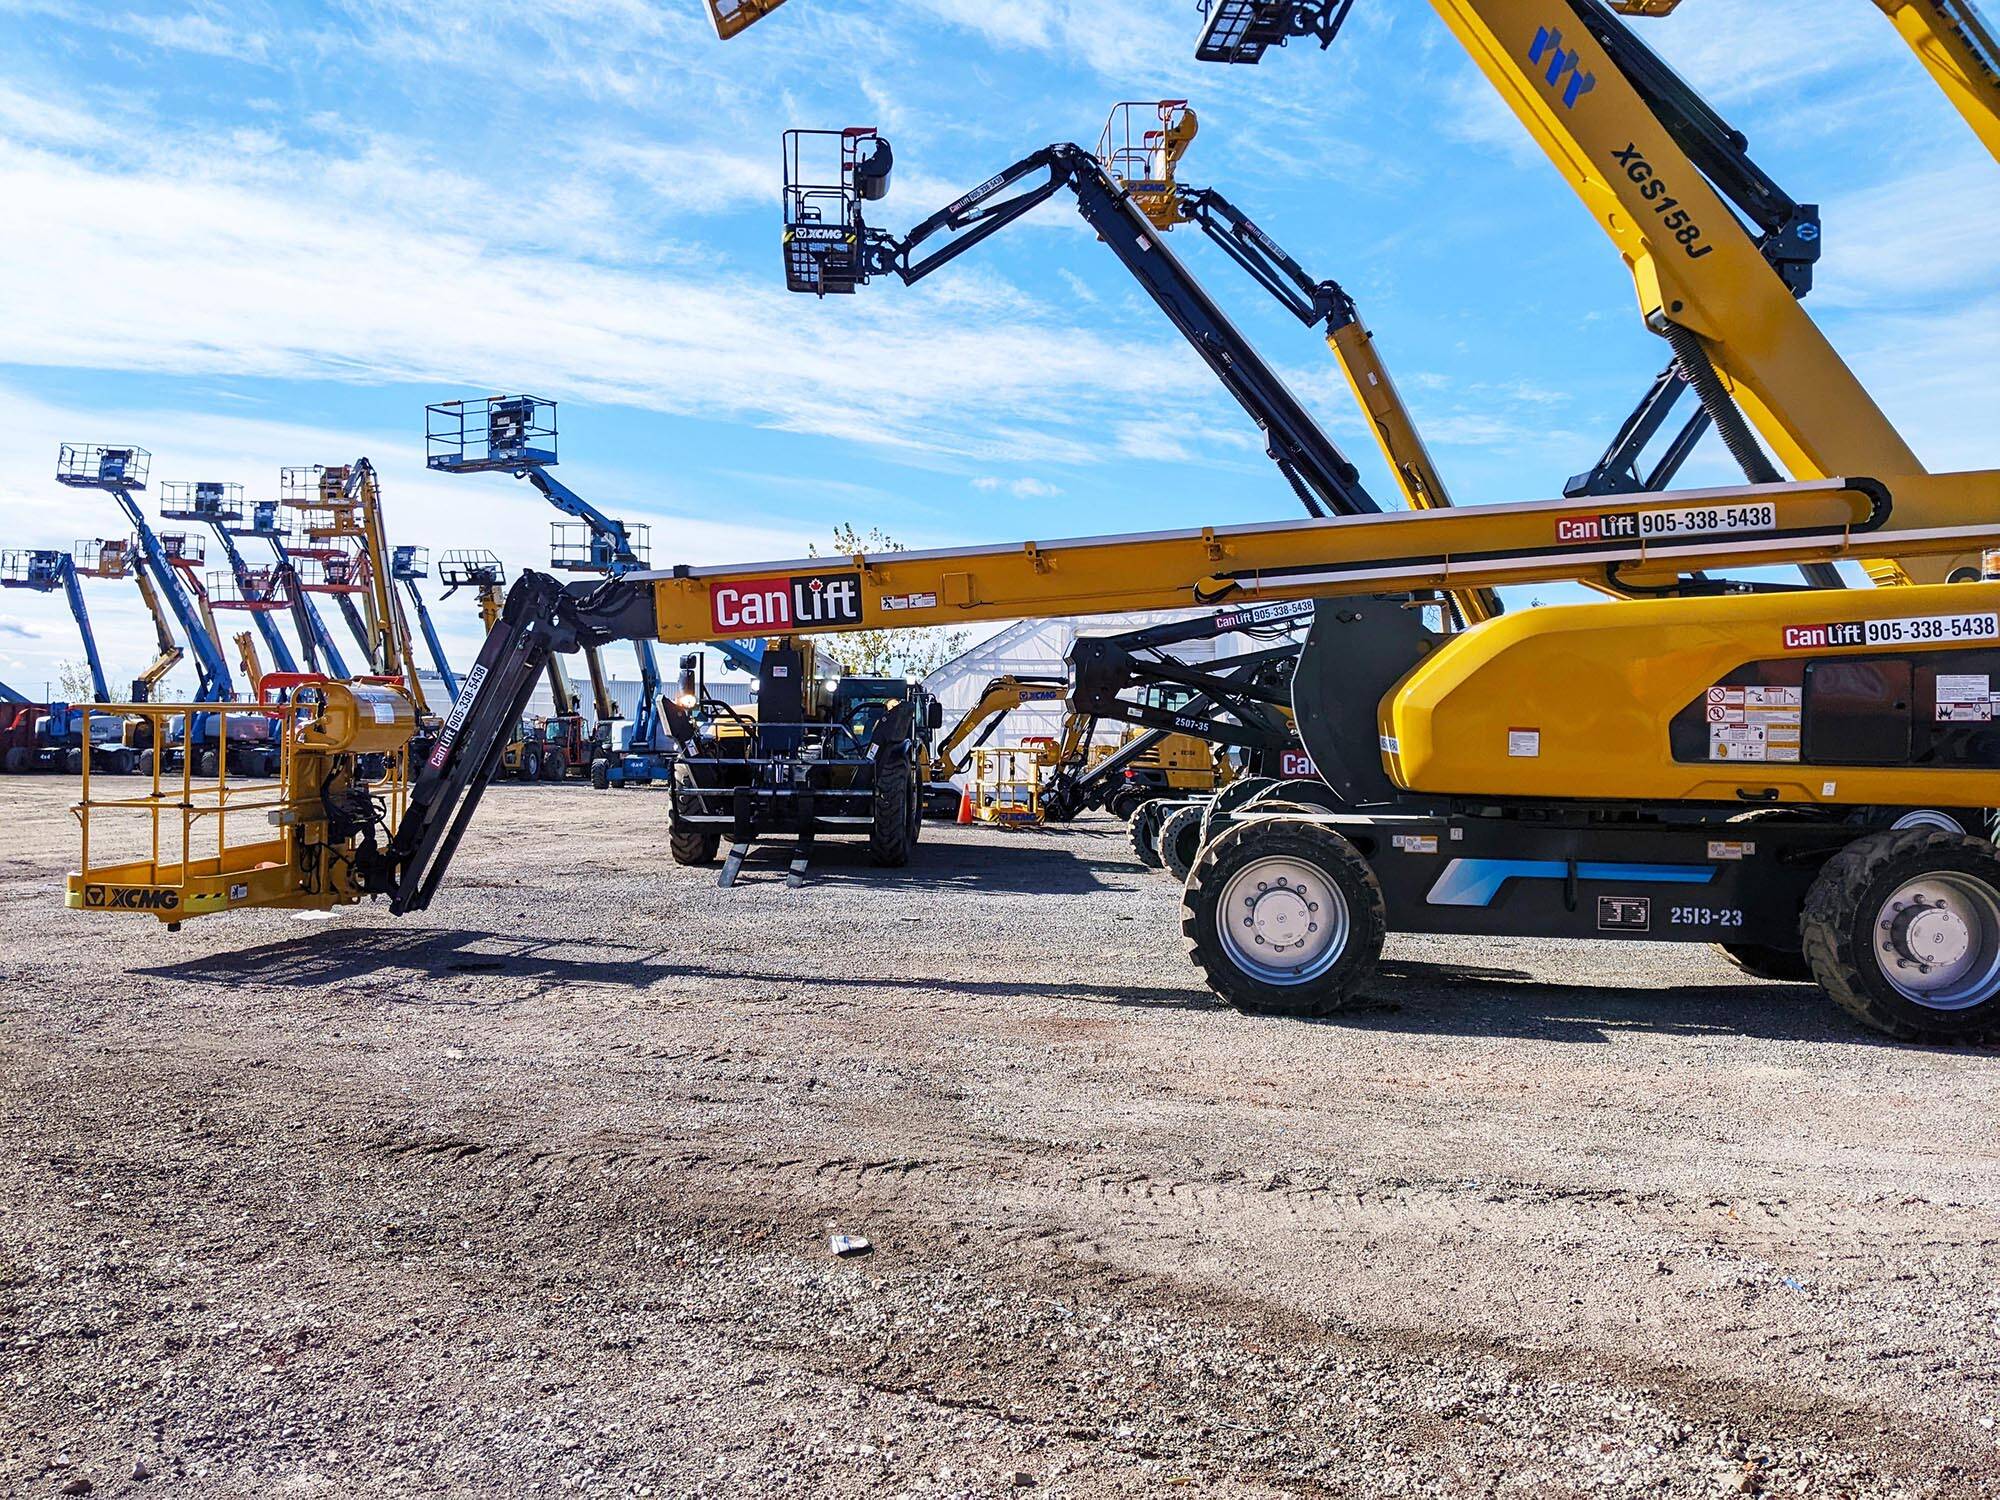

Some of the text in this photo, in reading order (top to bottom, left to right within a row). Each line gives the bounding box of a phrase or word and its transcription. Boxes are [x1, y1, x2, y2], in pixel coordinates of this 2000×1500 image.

[1611, 142, 1713, 259] XGS158J
[808, 228, 843, 239] XCMG
[1642, 506, 1772, 533] 905-338-5438
[1254, 601, 1313, 620] 905-338-5438
[1868, 616, 1995, 641] 905-338-5438
[450, 666, 486, 729] 905-338-5438
[1175, 717, 1209, 731] 2507-35
[107, 888, 179, 909] XCMG
[1671, 907, 1743, 926] 2513-23
